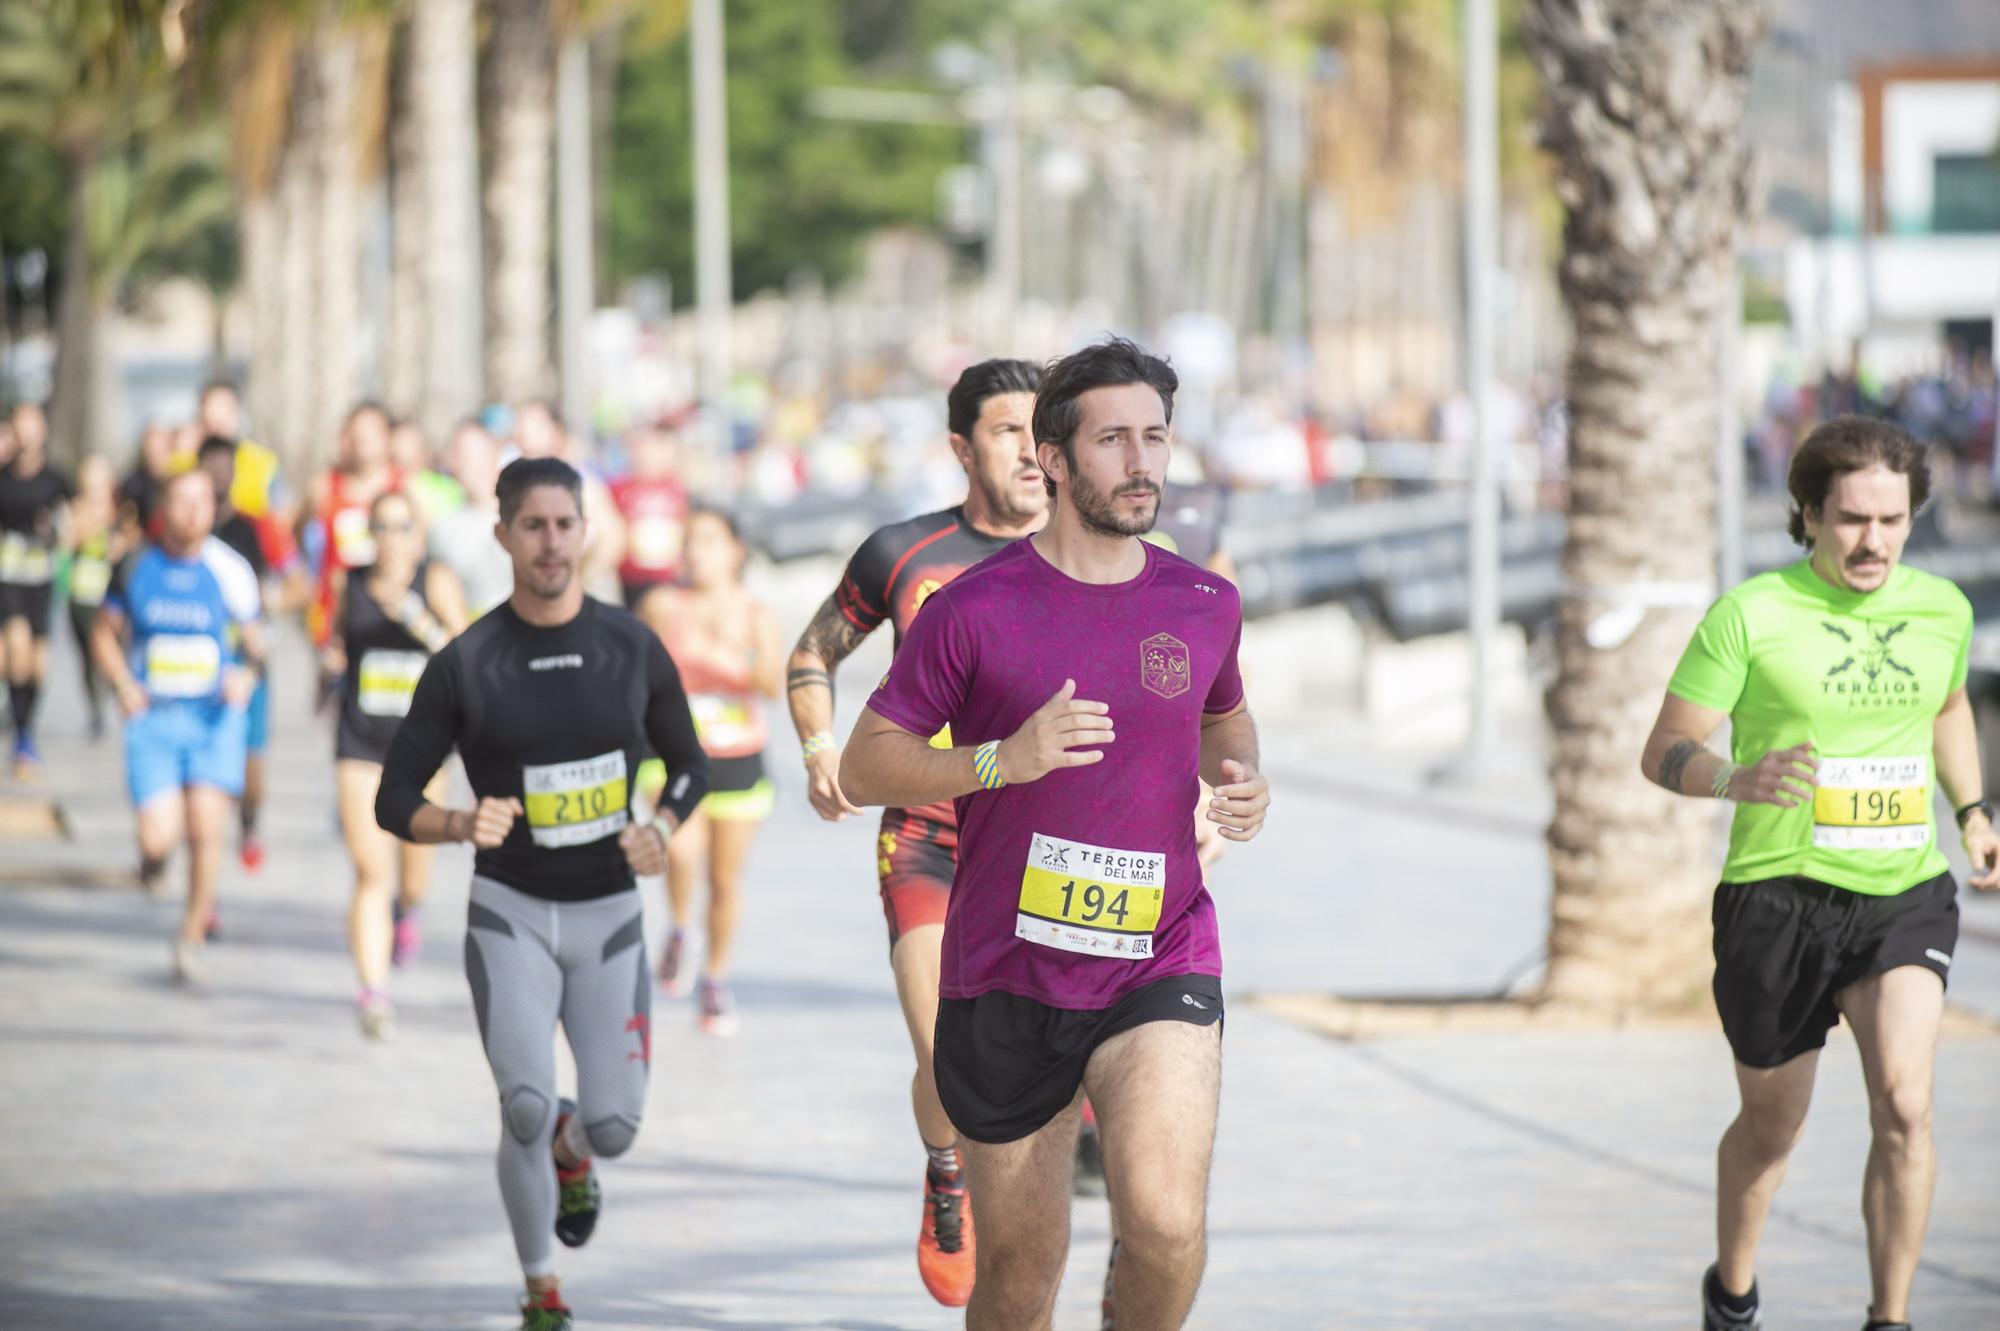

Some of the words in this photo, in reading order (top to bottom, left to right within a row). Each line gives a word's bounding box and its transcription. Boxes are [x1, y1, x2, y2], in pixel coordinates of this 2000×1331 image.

[1821, 681, 1920, 694] TERCIOS
[554, 785, 607, 821] 210
[1850, 789, 1902, 821] 196
[1081, 850, 1155, 870] TERCIOS
[1104, 867, 1128, 879] DEL
[1130, 870, 1155, 881] MAR
[1061, 880, 1129, 926] 194
